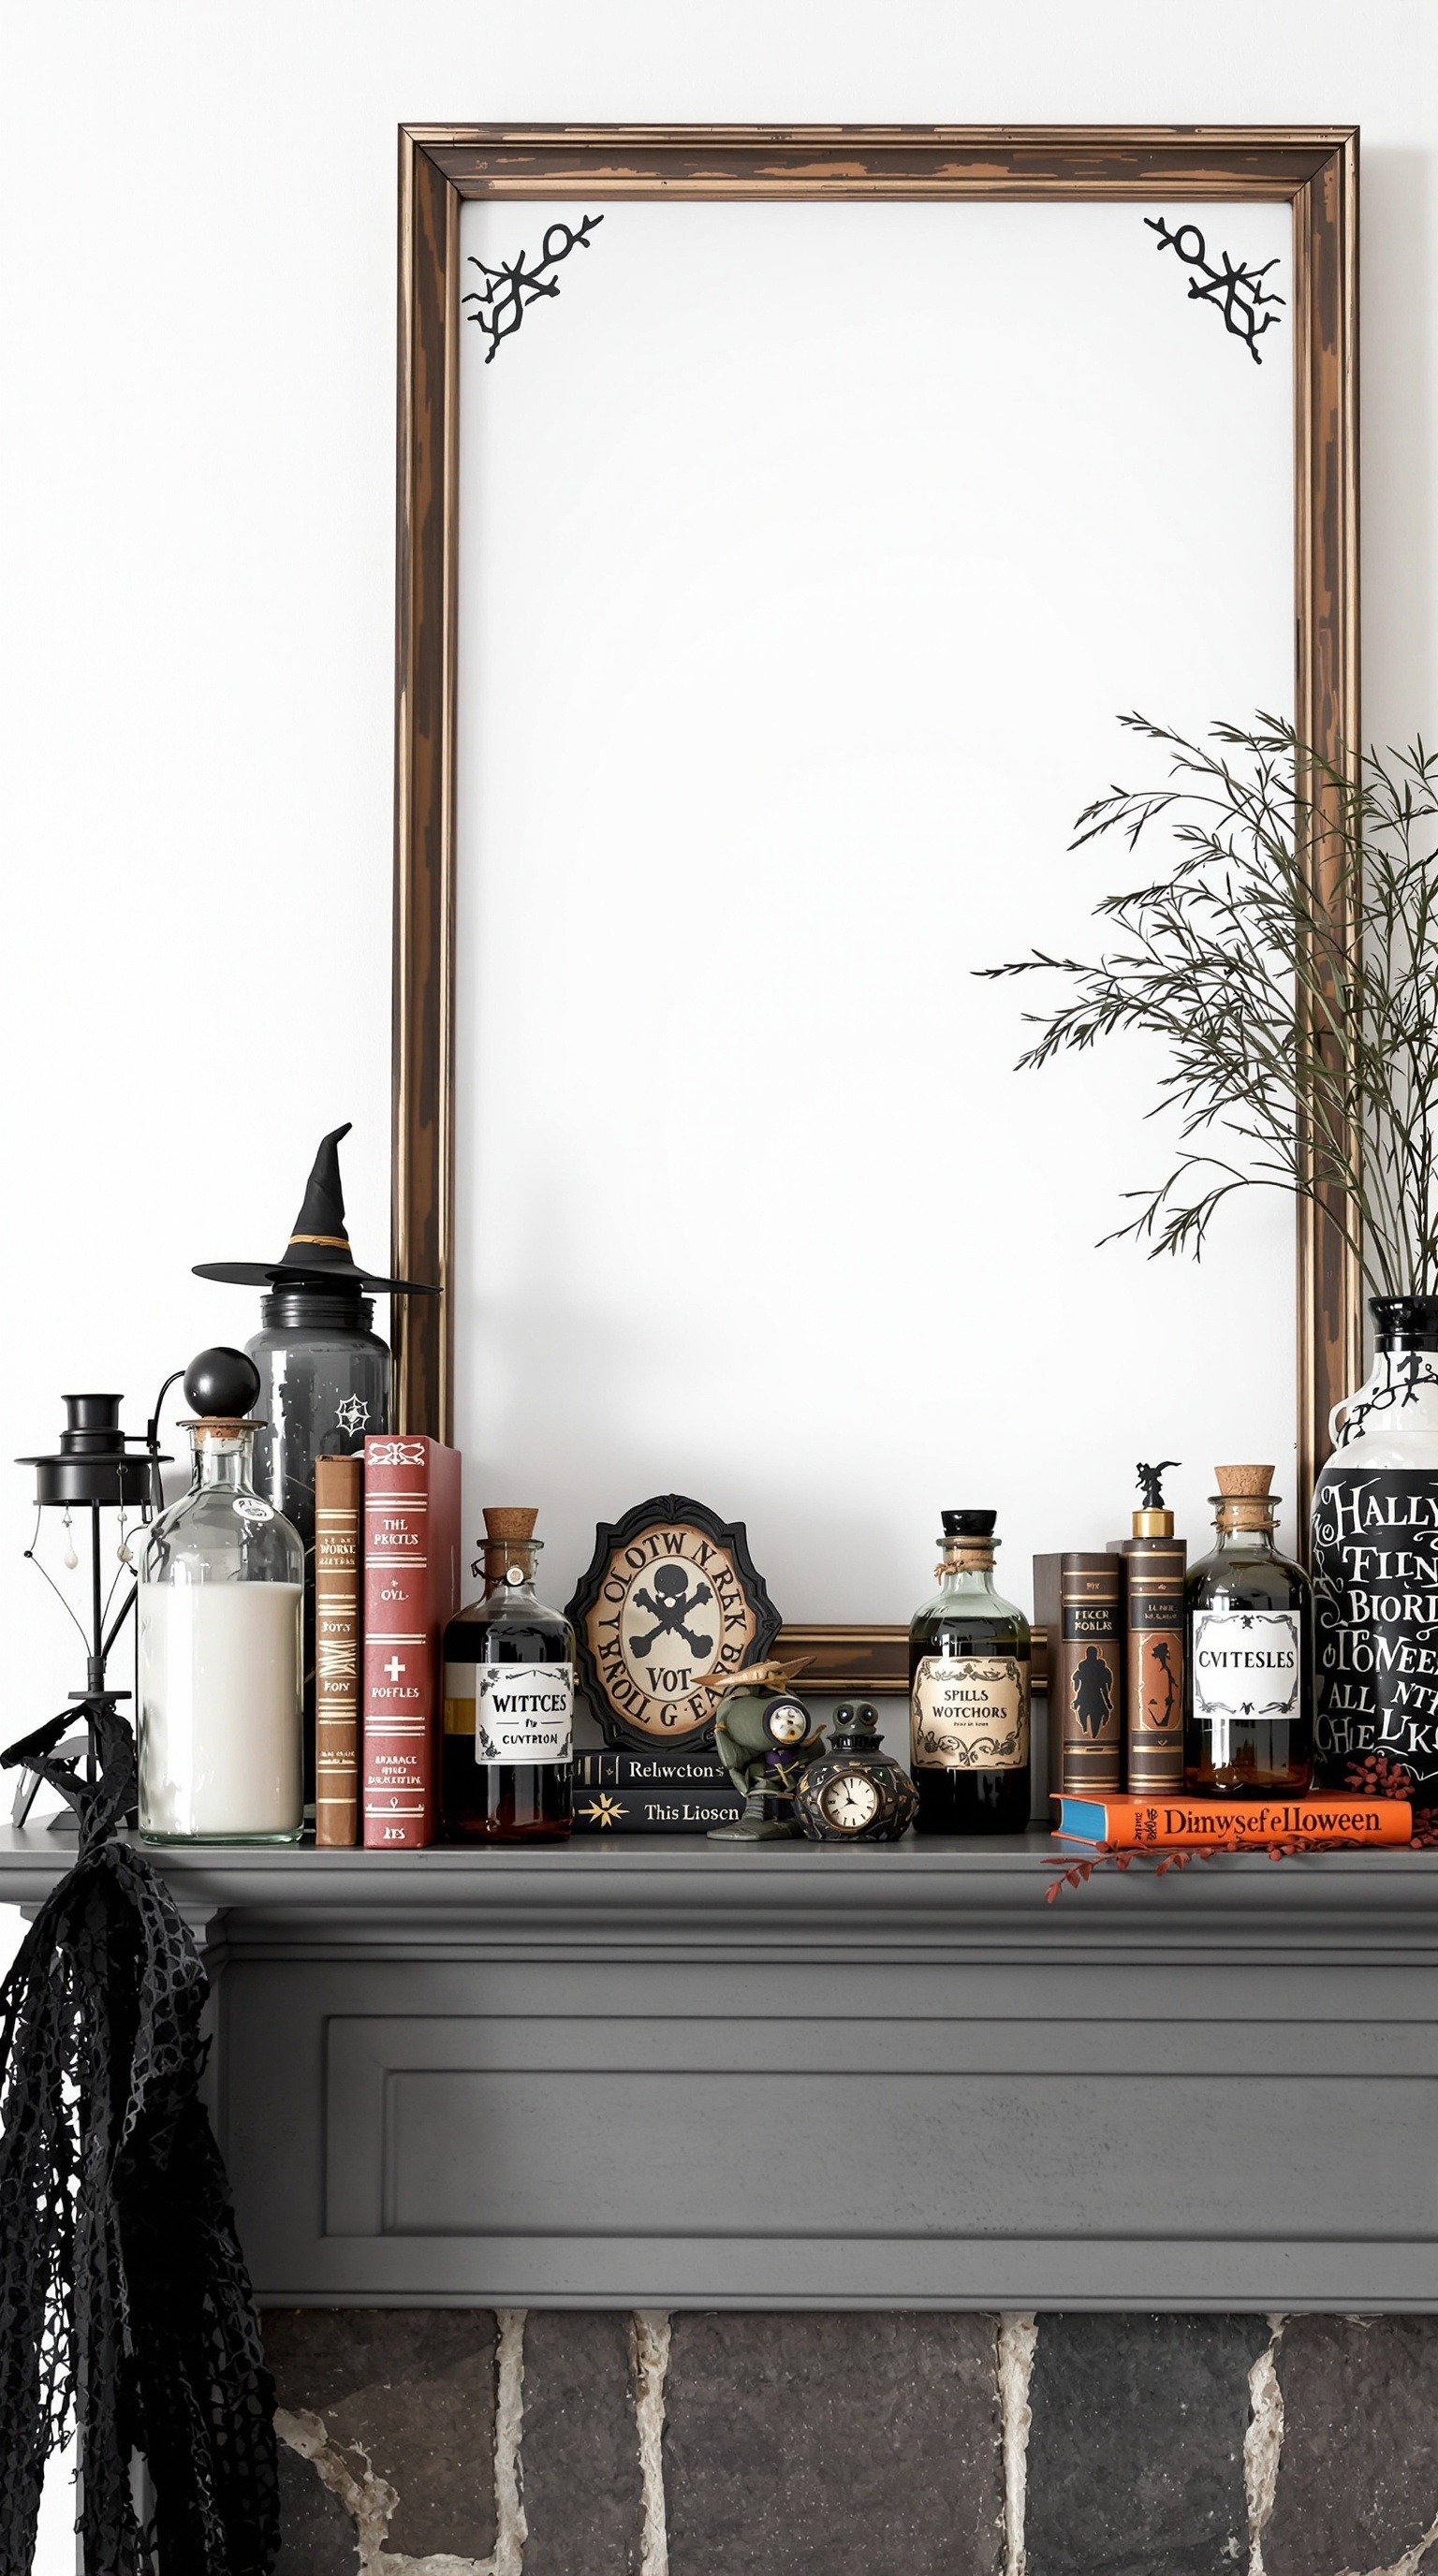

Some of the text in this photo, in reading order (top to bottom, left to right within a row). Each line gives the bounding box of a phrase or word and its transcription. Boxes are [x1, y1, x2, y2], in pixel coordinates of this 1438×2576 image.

[646, 1667, 692, 1692] VOT
[492, 1694, 567, 1713] WITTCES
[944, 1690, 989, 1702] SPILLS
[932, 1705, 1008, 1720] WOTCHORS
[644, 1804, 680, 1821] This
